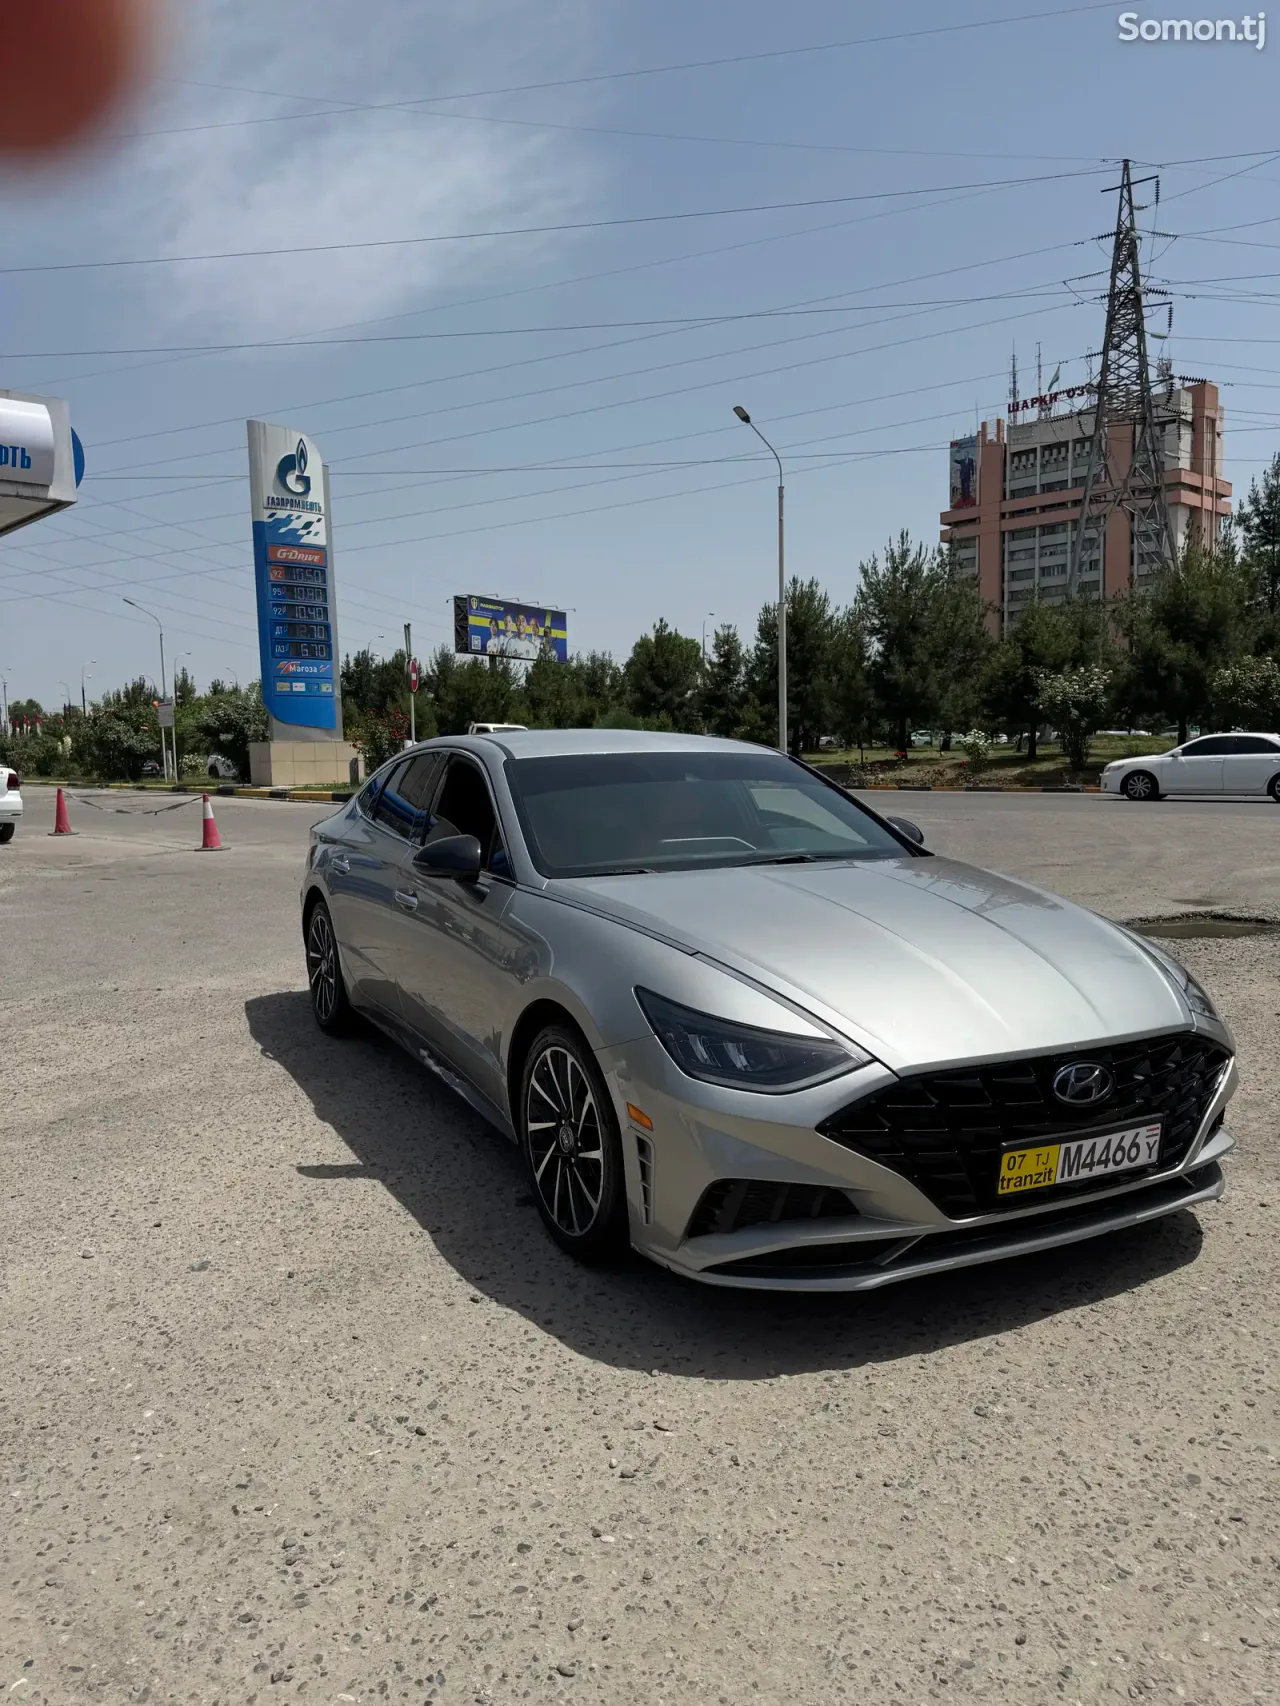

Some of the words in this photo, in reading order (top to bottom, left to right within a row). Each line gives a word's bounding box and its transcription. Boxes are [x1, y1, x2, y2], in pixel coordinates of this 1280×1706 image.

[267, 496, 322, 512] ГАЗПРОМНЕФТЬ
[273, 569, 282, 579] 92
[272, 587, 282, 596] 95
[294, 586, 323, 601] 10.80
[273, 607, 283, 616] 92
[295, 605, 324, 620] 10.40
[275, 626, 283, 635] ДТ
[275, 644, 285, 653] ГАЗ
[301, 643, 326, 657] 6.70
[1007, 1154, 1027, 1171] 07
[1035, 1152, 1050, 1165] TJ
[1060, 1132, 1141, 1178] M4466
[1146, 1139, 1158, 1159] Y
[1000, 1167, 1053, 1190] tranzit
